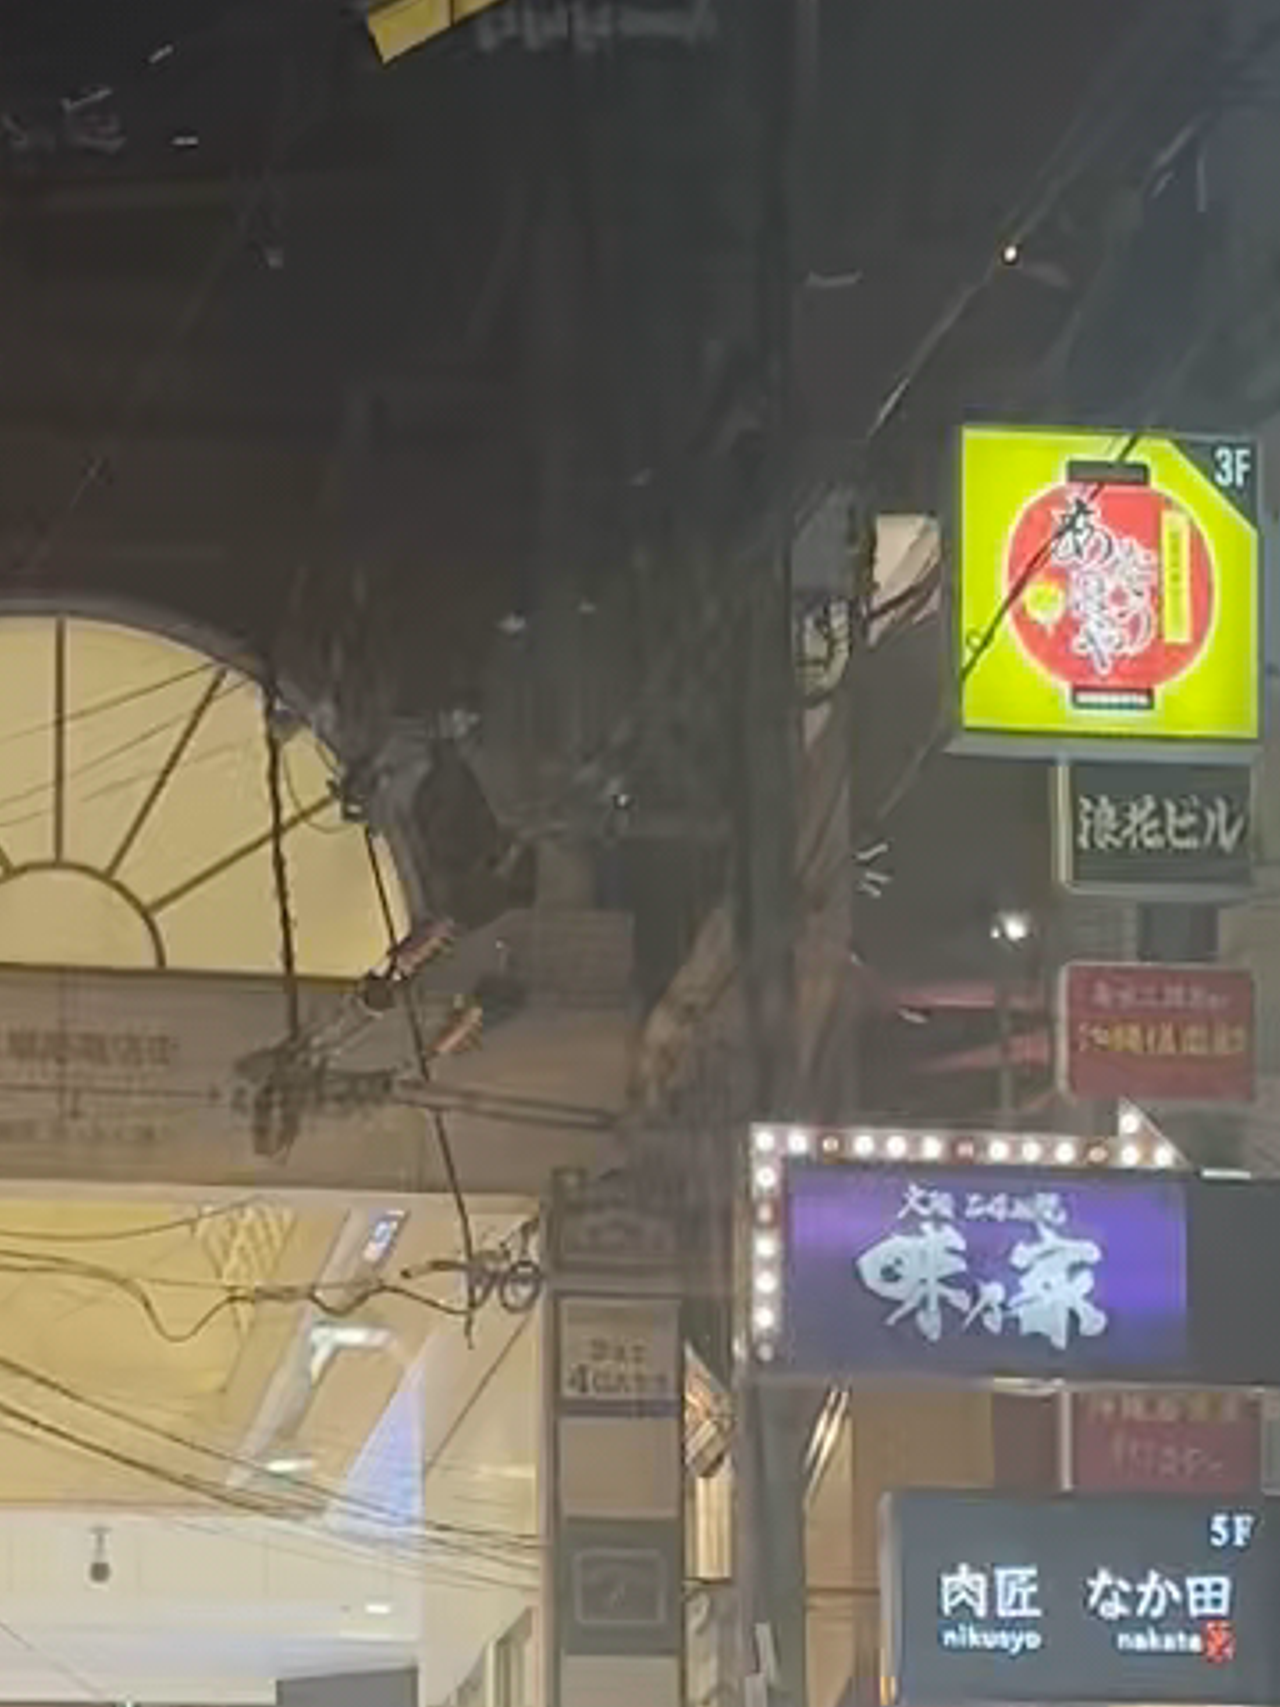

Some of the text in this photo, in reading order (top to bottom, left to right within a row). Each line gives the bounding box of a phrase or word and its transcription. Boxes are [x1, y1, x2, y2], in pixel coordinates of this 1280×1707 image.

[1214, 446, 1252, 488] 3F
[1076, 792, 1249, 854] 浪花ビル
[856, 1219, 1108, 1349] 味乃家
[1209, 1514, 1256, 1549] 5F
[940, 1562, 1233, 1621] 肉匠 なか田
[941, 1624, 1043, 1659] nikusyo
